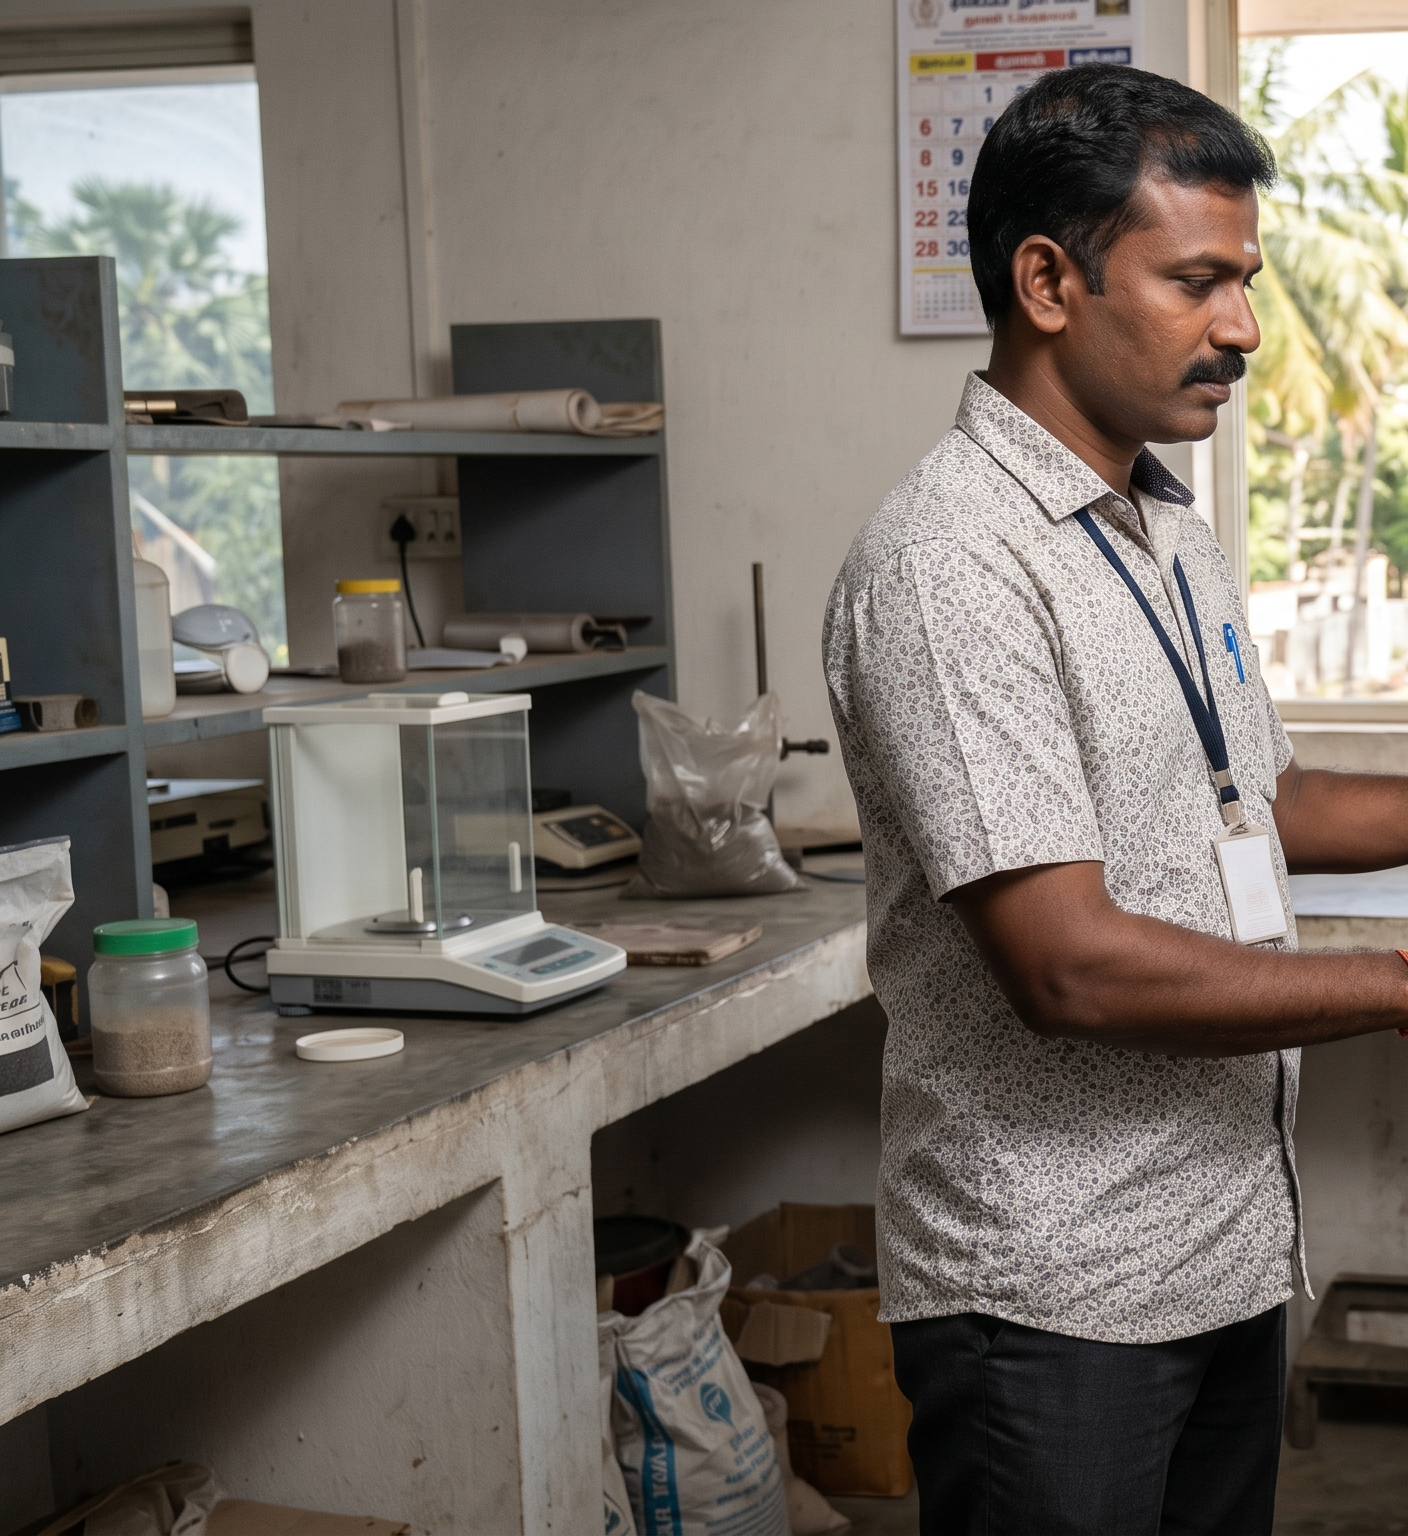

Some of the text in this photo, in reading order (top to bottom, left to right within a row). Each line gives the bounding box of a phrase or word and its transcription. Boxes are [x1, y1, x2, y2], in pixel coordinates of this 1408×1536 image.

[984, 86, 992, 103] 1
[919, 118, 931, 136] 6
[951, 117, 963, 135] 7
[919, 148, 964, 167] 8 9
[916, 179, 969, 197] 15 16
[915, 210, 939, 228] 22
[915, 240, 970, 257] 28 30
